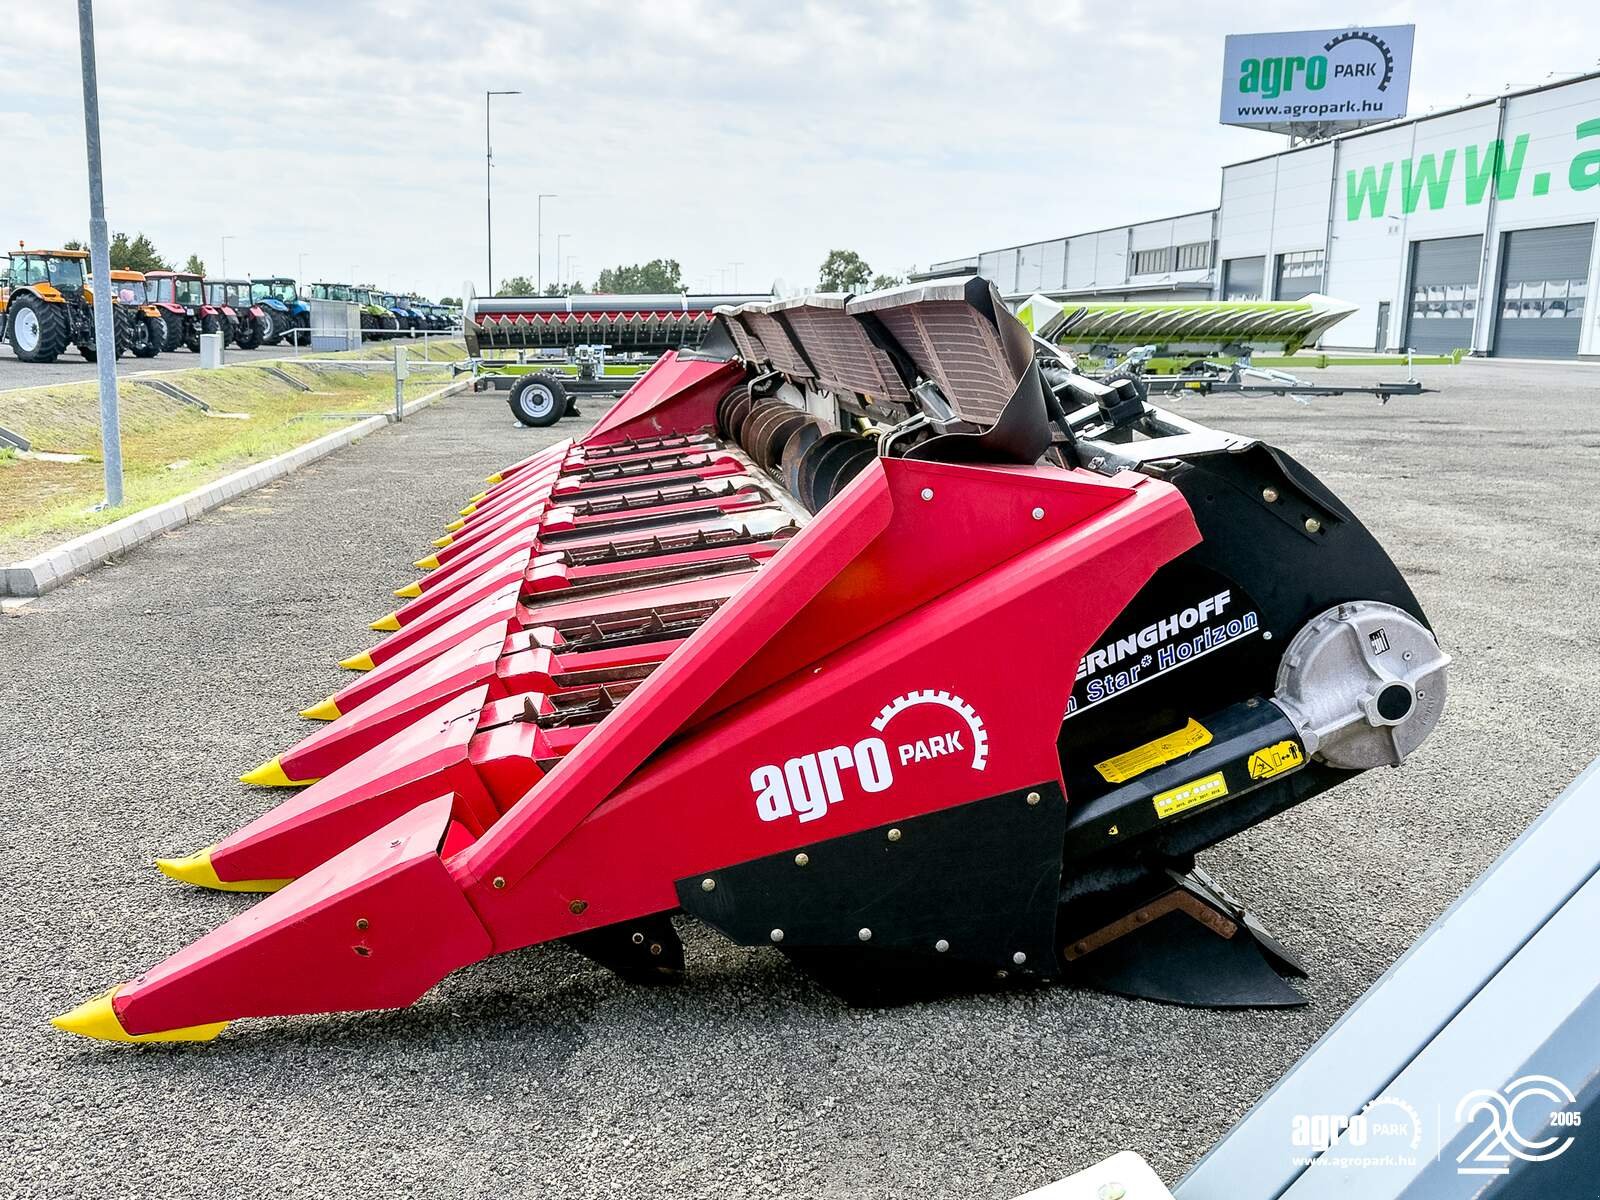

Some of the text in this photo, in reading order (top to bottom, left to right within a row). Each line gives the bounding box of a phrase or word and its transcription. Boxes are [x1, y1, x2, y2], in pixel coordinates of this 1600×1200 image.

[1239, 55, 1377, 99] agro PARK
[1238, 100, 1384, 118] www.agropark.hu
[1157, 611, 1258, 671] Horizon
[750, 730, 964, 824] agro PARK
